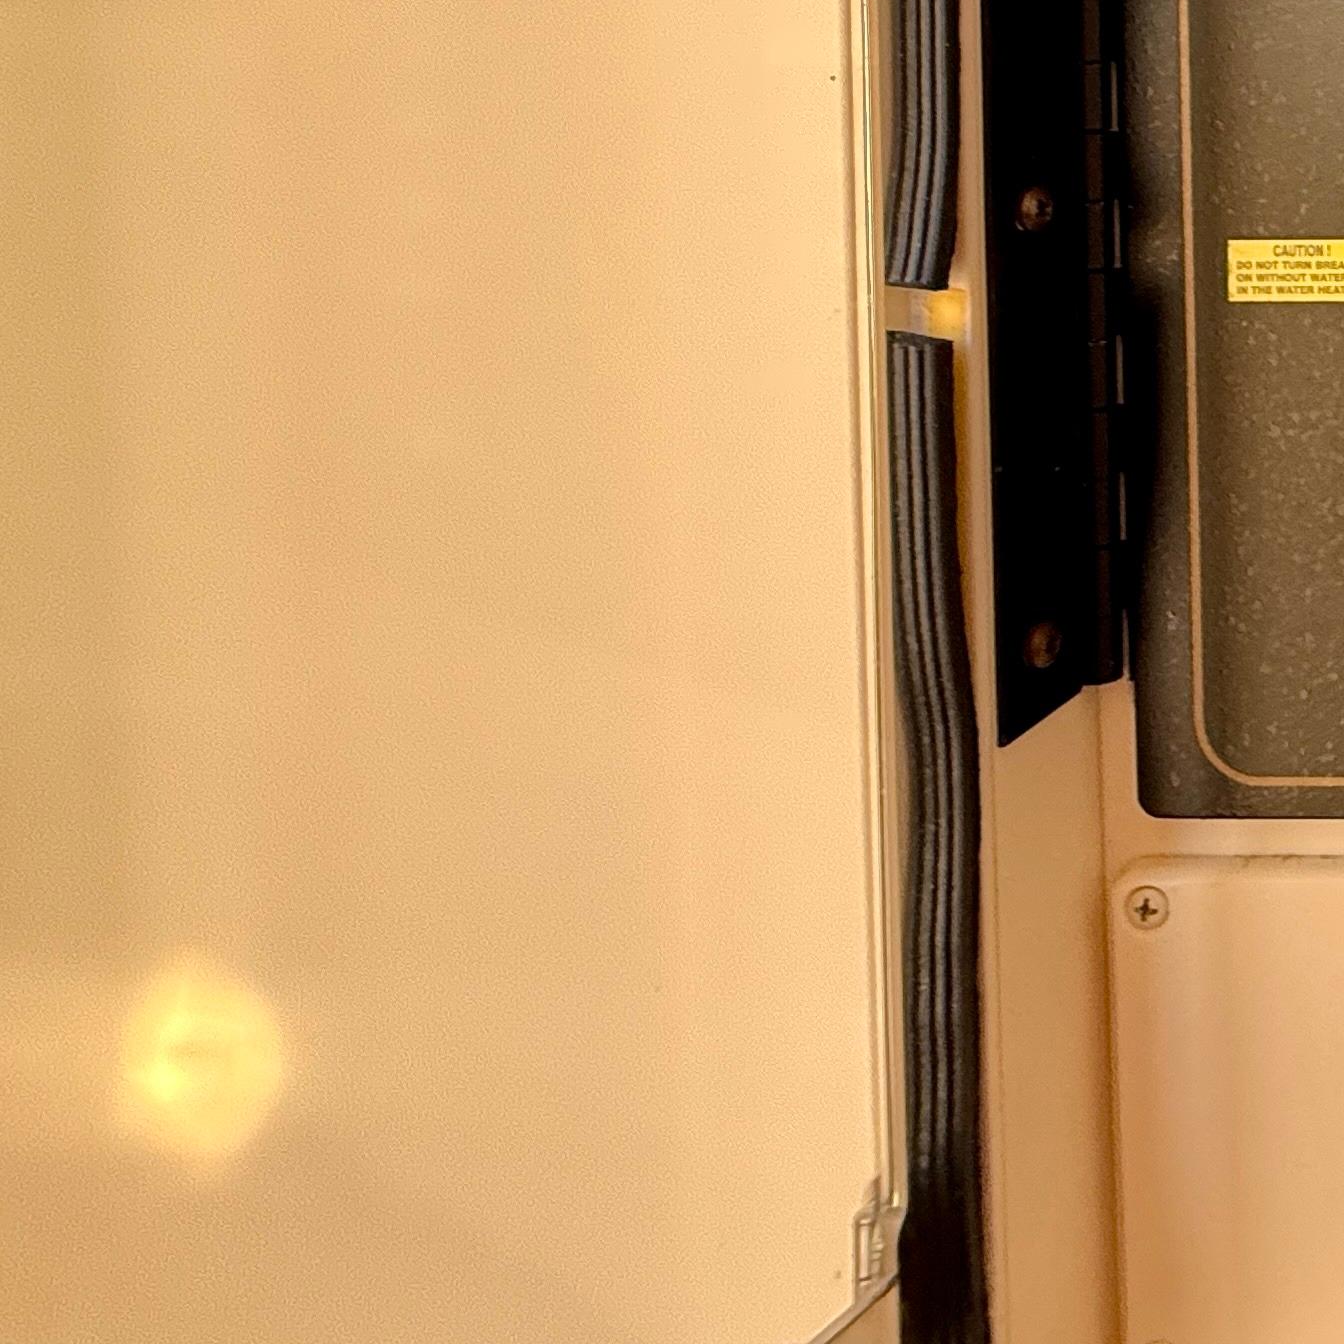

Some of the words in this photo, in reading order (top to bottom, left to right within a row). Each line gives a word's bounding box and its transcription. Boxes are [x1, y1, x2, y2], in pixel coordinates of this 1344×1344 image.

[1236, 261, 1252, 270] DO
[1256, 261, 1278, 270] NOT
[1282, 261, 1312, 270] TURN
[1256, 273, 1306, 282] WITHOUT
[1237, 286, 1248, 294] IN
[1251, 286, 1272, 294] THE
[1276, 286, 1314, 294] WATER
